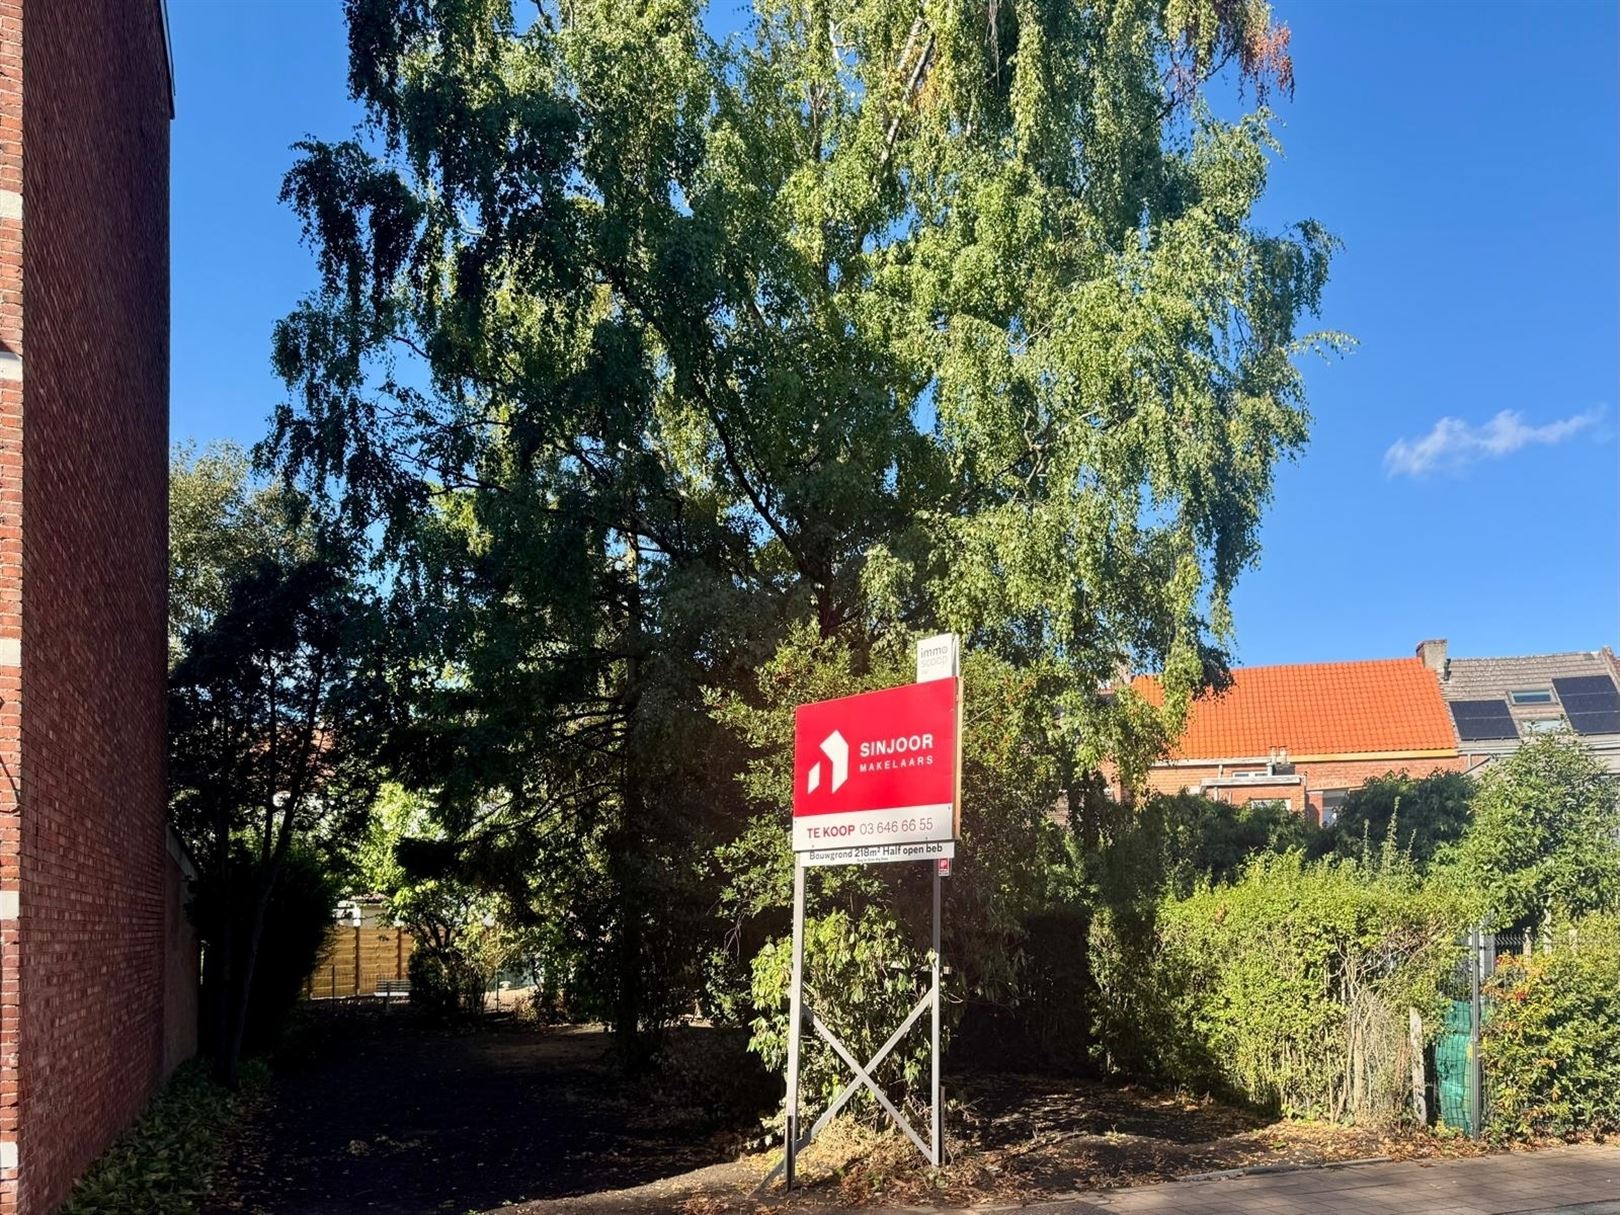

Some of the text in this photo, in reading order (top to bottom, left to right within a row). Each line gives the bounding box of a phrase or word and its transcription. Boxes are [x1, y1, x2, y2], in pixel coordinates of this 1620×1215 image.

[921, 646, 948, 659] immo
[861, 734, 933, 758] SINJOOR
[860, 756, 933, 772] MAKELAARS
[807, 818, 932, 840] TE KOOP 03 646 66 55
[809, 850, 852, 861] Bouwgrond
[882, 844, 901, 856] Half
[902, 845, 924, 856] open
[926, 843, 942, 853] beb
